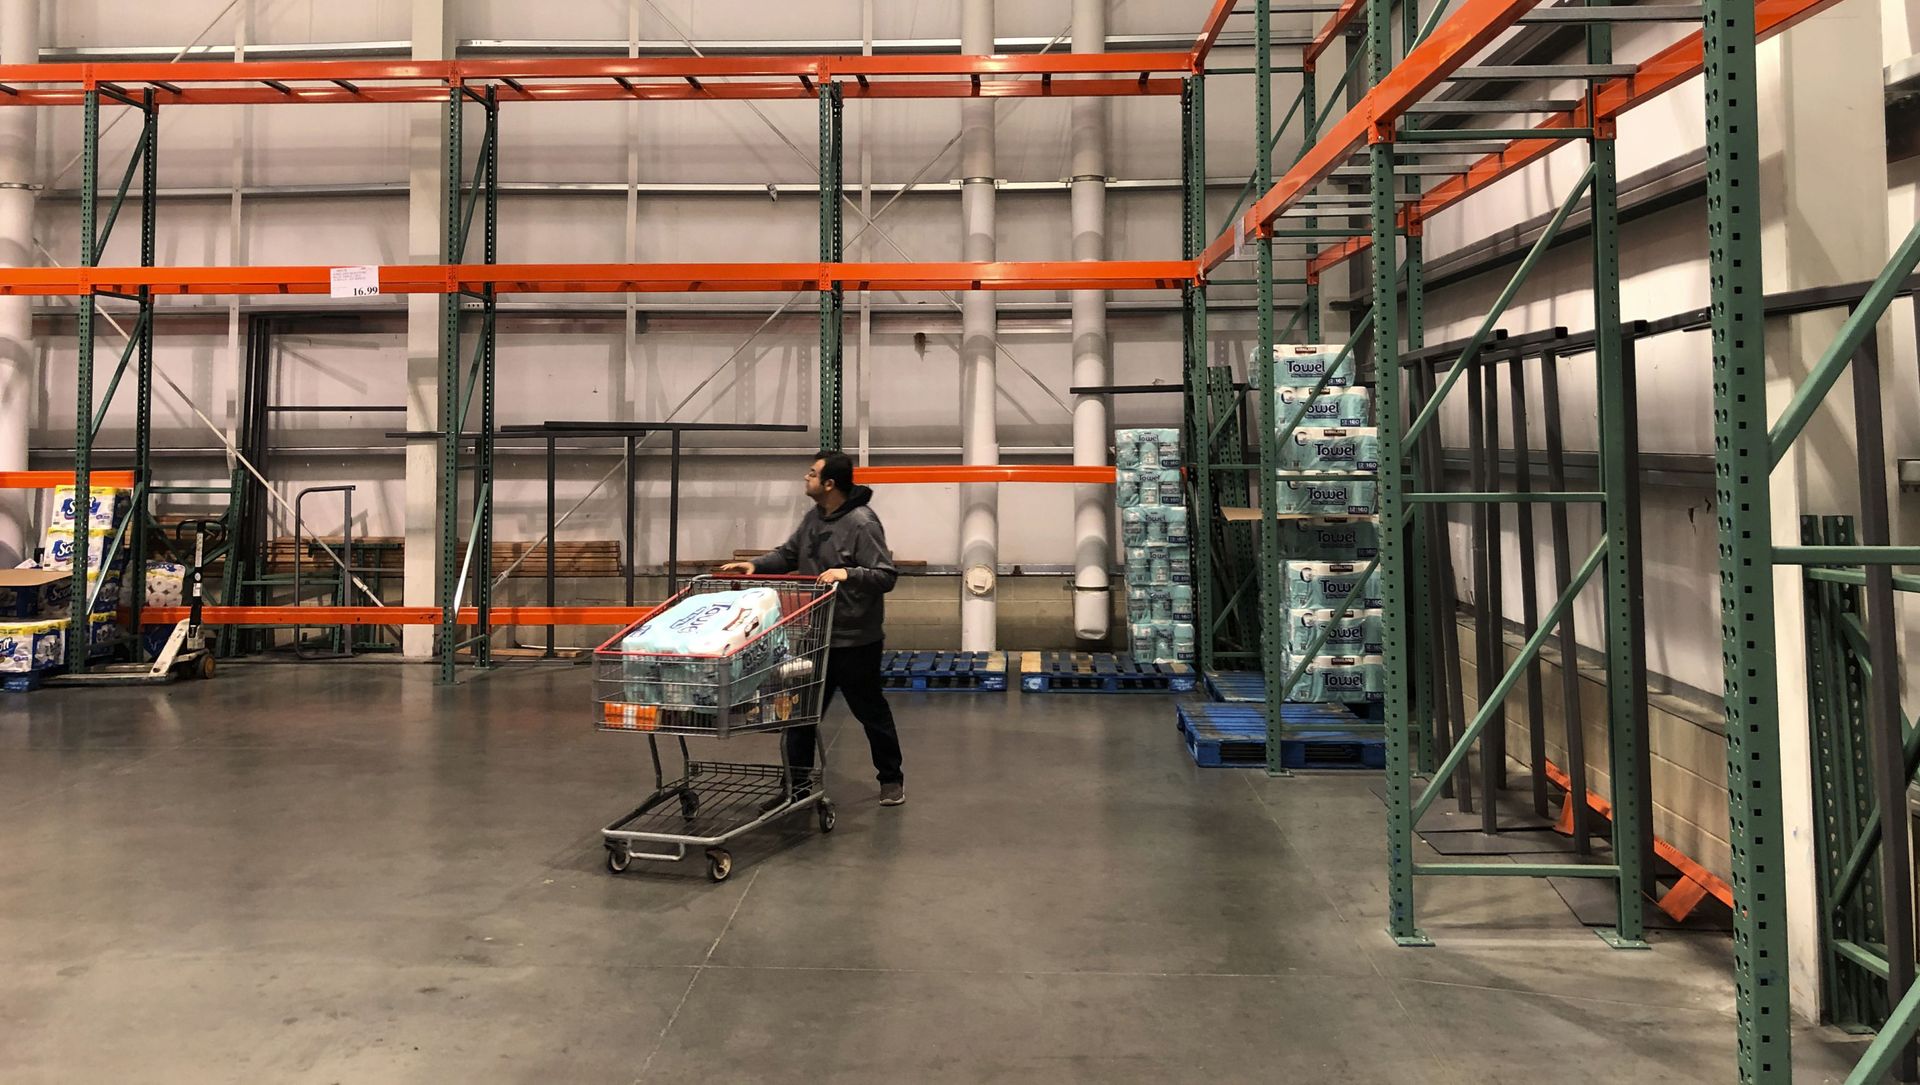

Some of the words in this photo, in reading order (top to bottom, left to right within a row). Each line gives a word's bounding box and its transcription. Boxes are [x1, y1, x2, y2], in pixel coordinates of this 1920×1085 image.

[353, 286, 378, 296] 16.99
[1286, 360, 1325, 373] Towel
[1300, 402, 1340, 413] owel
[1314, 443, 1356, 456] Towel
[1306, 487, 1348, 500] Towel
[1317, 529, 1356, 543] Towel
[1321, 580, 1355, 593] Tow
[1320, 625, 1364, 638] owel
[1322, 672, 1364, 686] Towel
